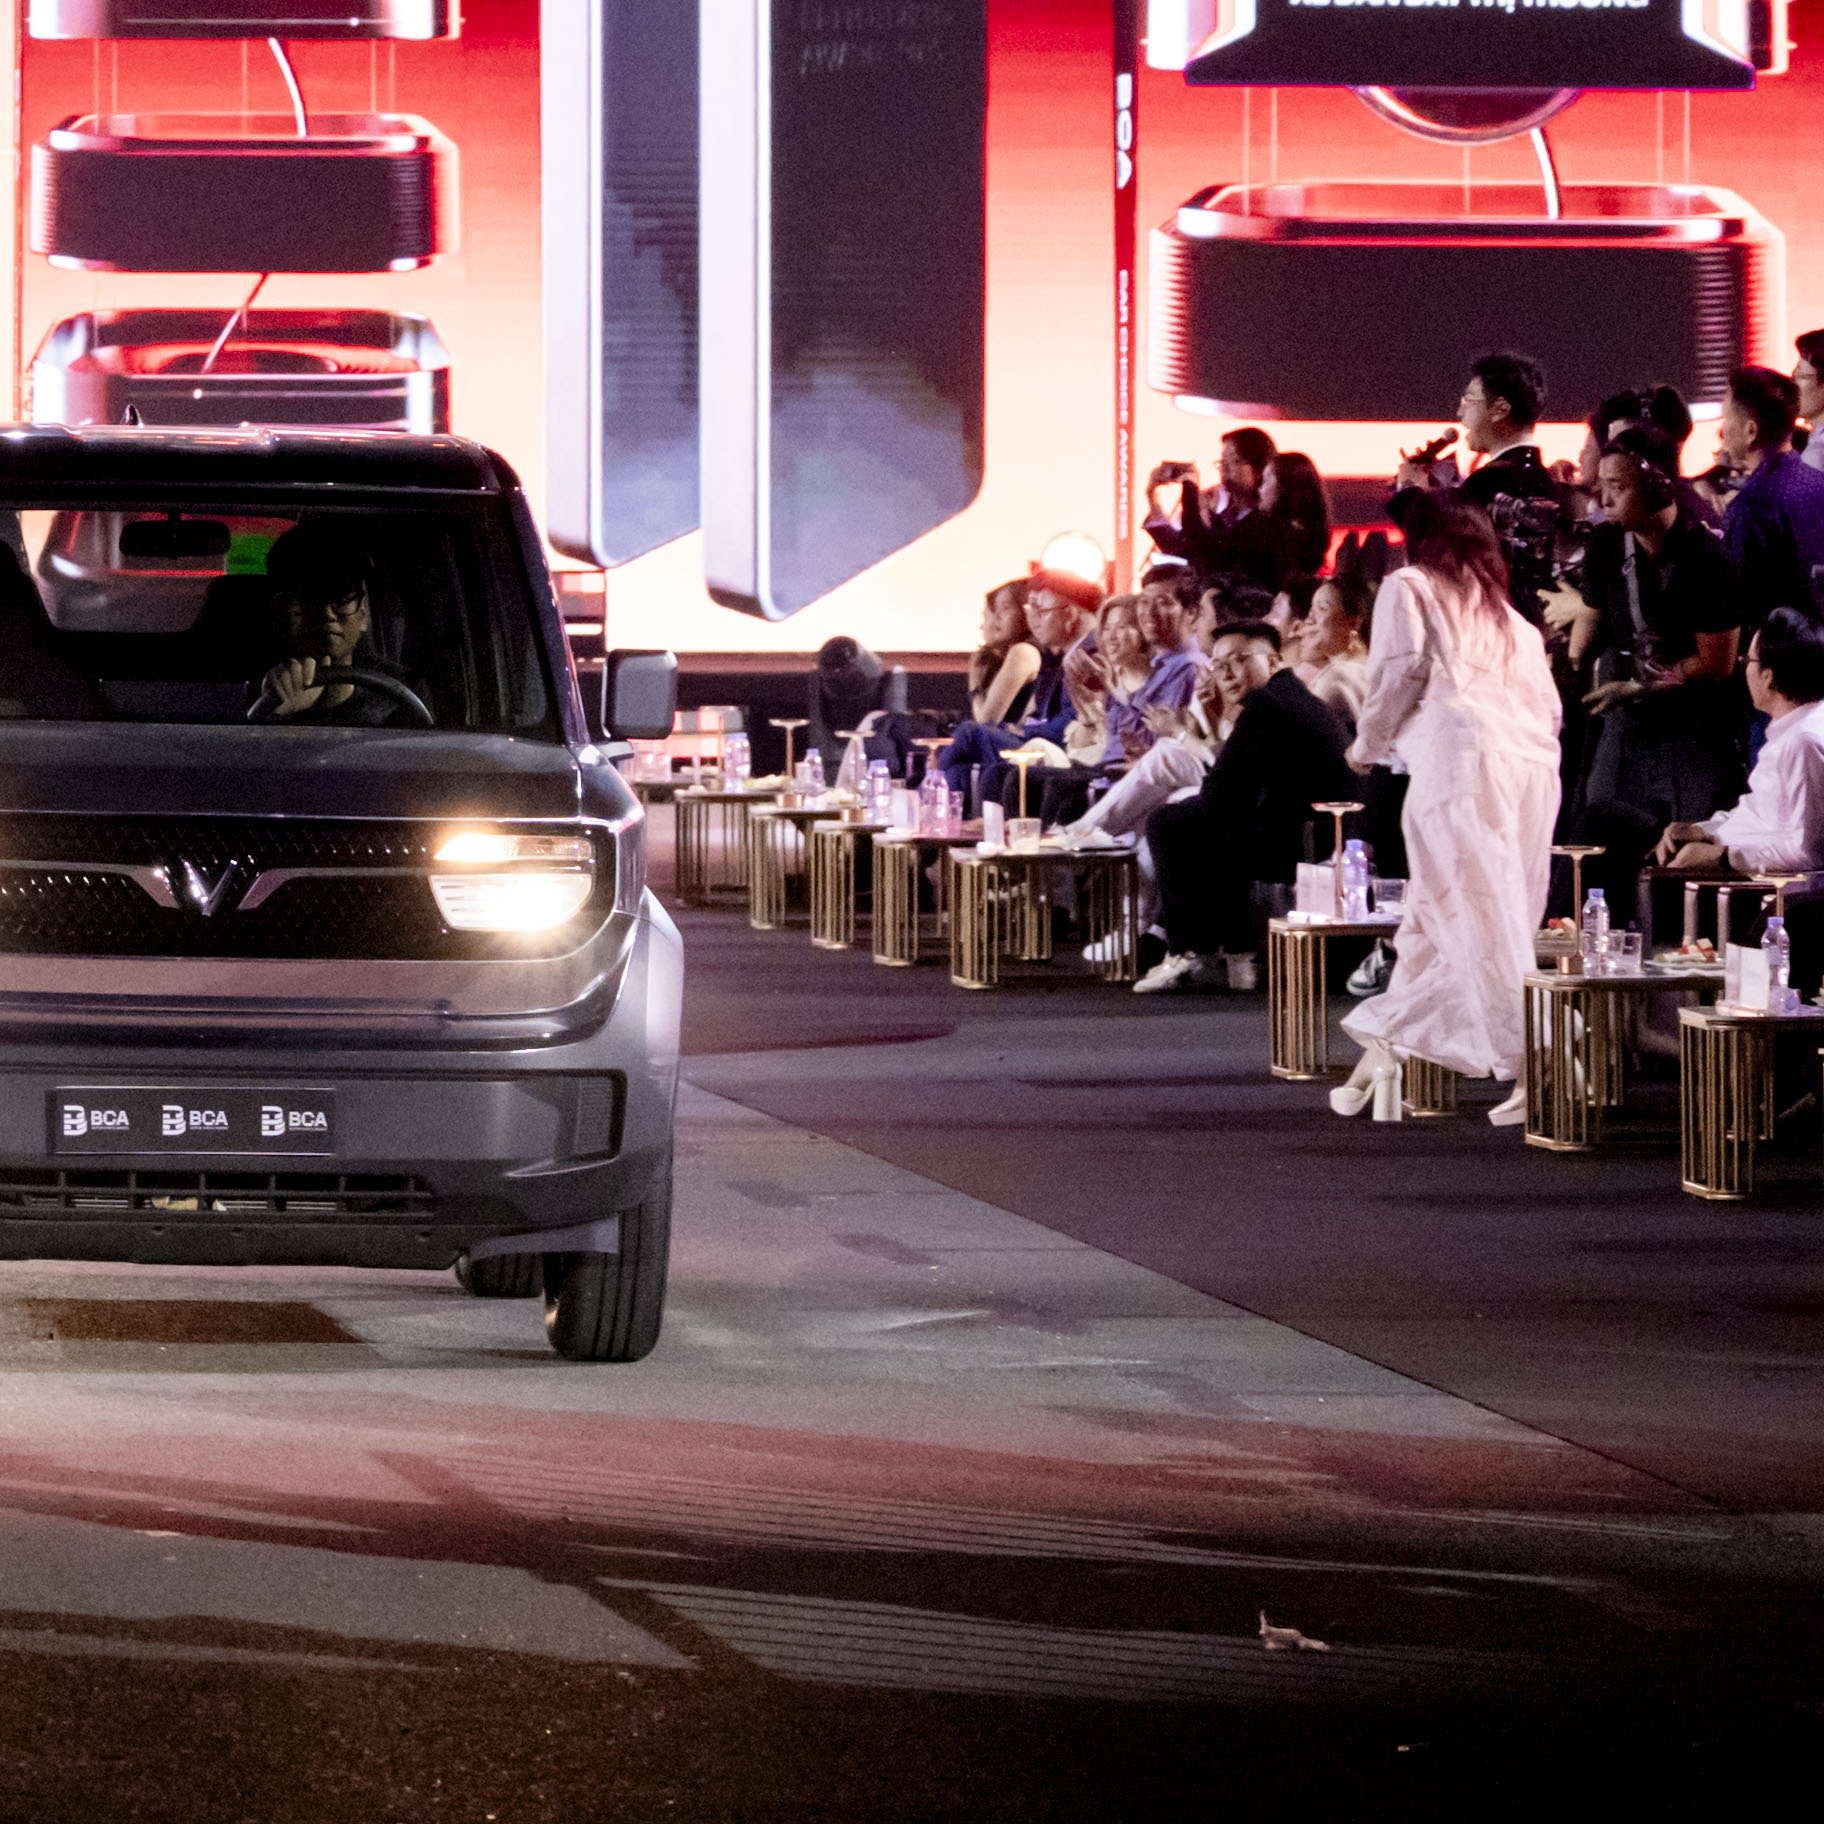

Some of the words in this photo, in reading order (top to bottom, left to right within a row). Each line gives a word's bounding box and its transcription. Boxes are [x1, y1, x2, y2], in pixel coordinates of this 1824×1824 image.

[90, 1110, 130, 1126] BCA
[189, 1110, 228, 1126] BCA
[288, 1111, 328, 1127] BCA
